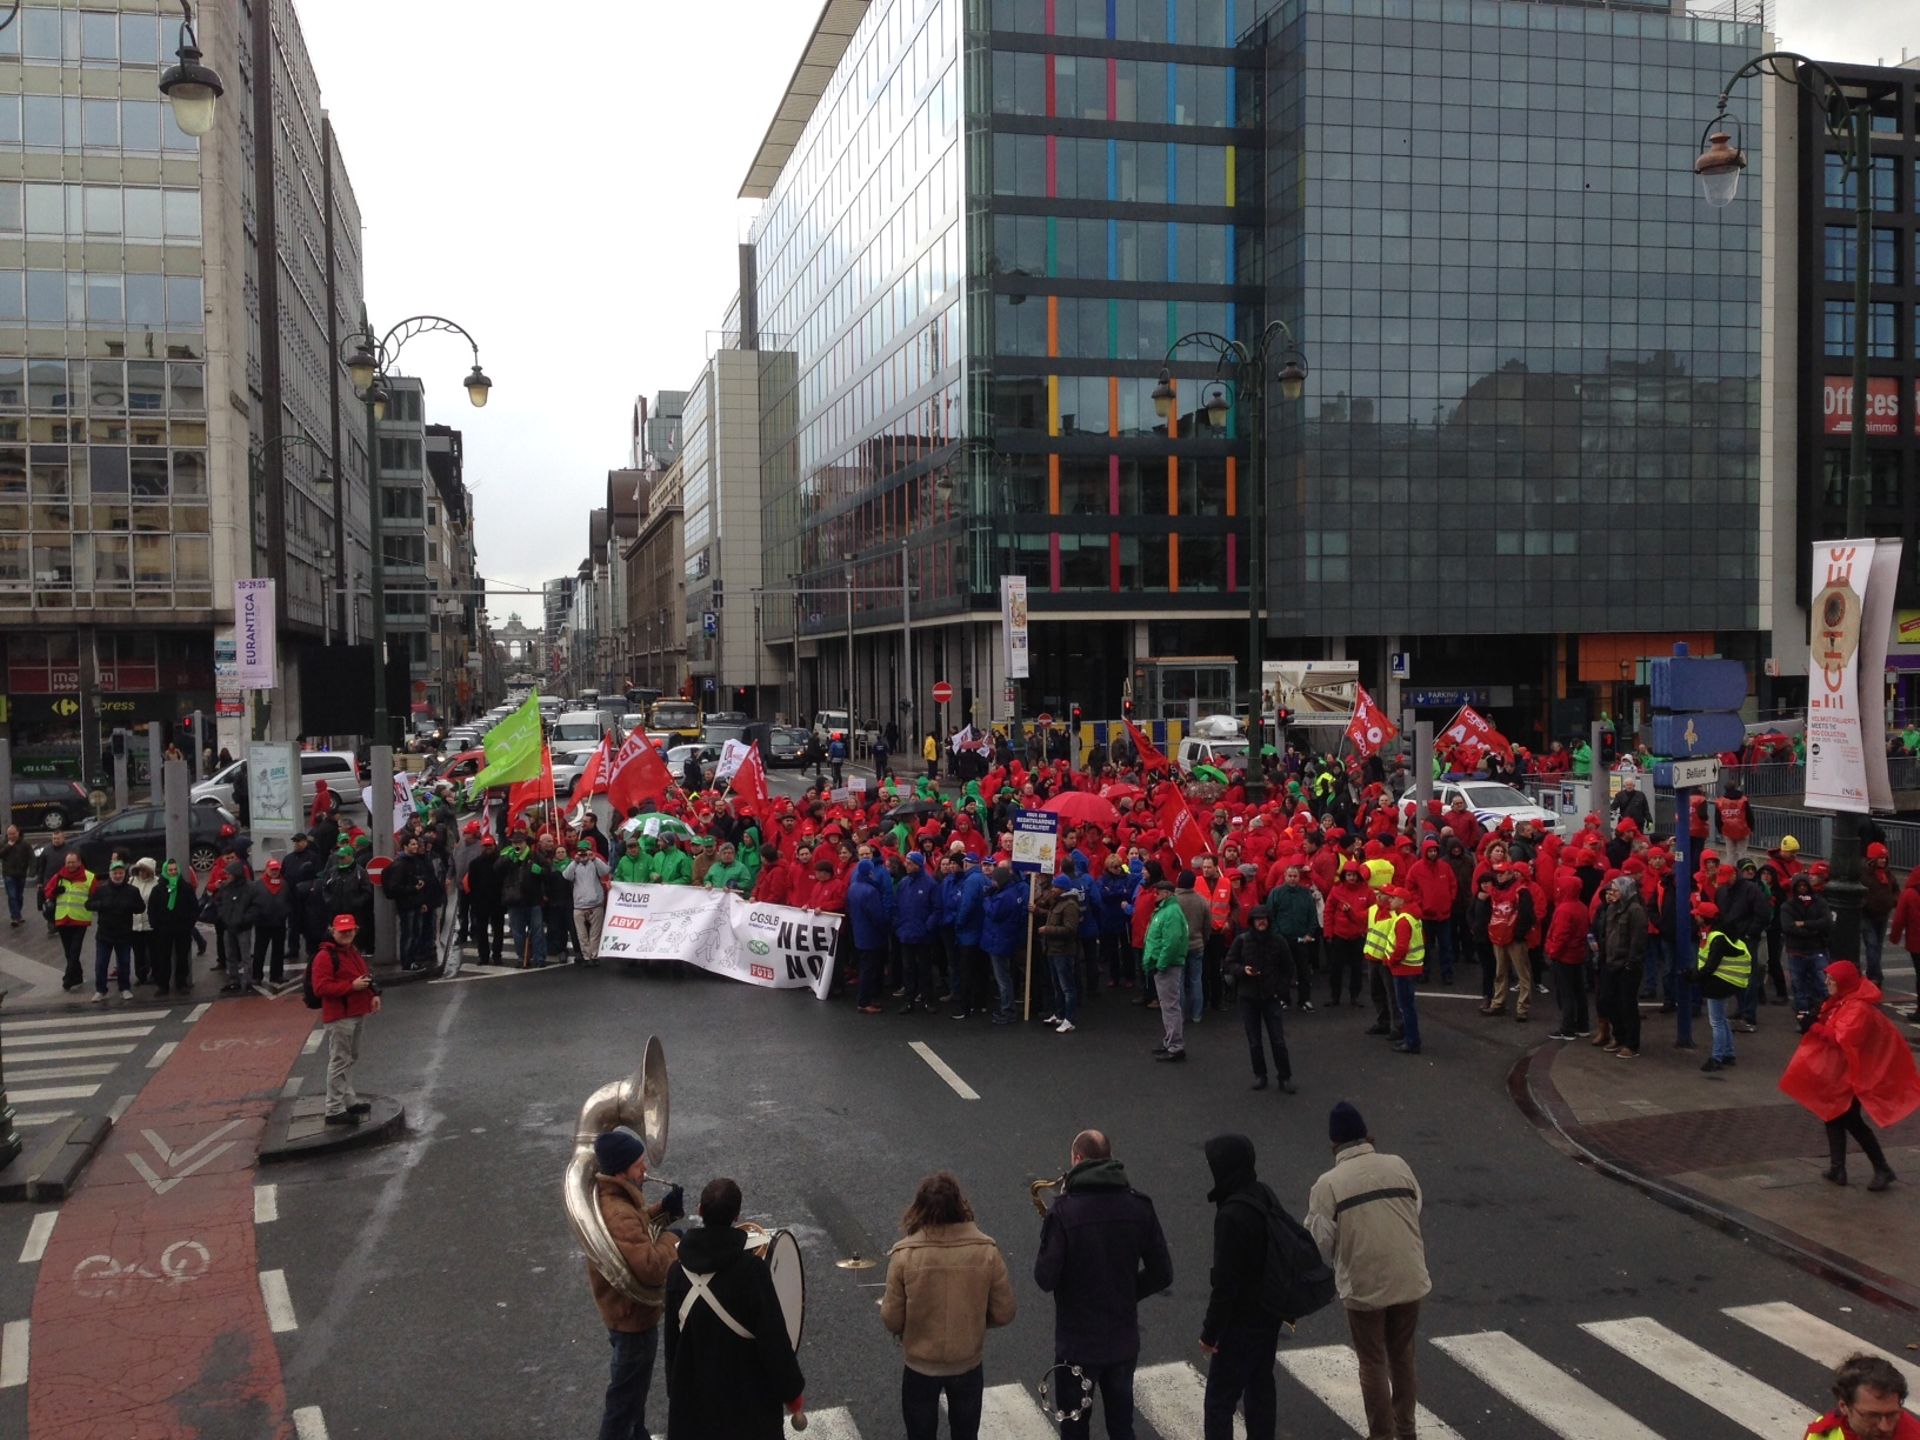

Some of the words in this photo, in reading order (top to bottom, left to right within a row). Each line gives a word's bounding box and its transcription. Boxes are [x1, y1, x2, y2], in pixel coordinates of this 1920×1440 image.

[1824, 386, 1899, 416] Offces
[245, 593, 256, 665] EURANTICA
[617, 892, 650, 903] ACLVB
[610, 916, 641, 929] ABVV
[749, 911, 779, 926] CGSLB
[610, 942, 630, 951] ACV
[752, 965, 773, 979] FGTB
